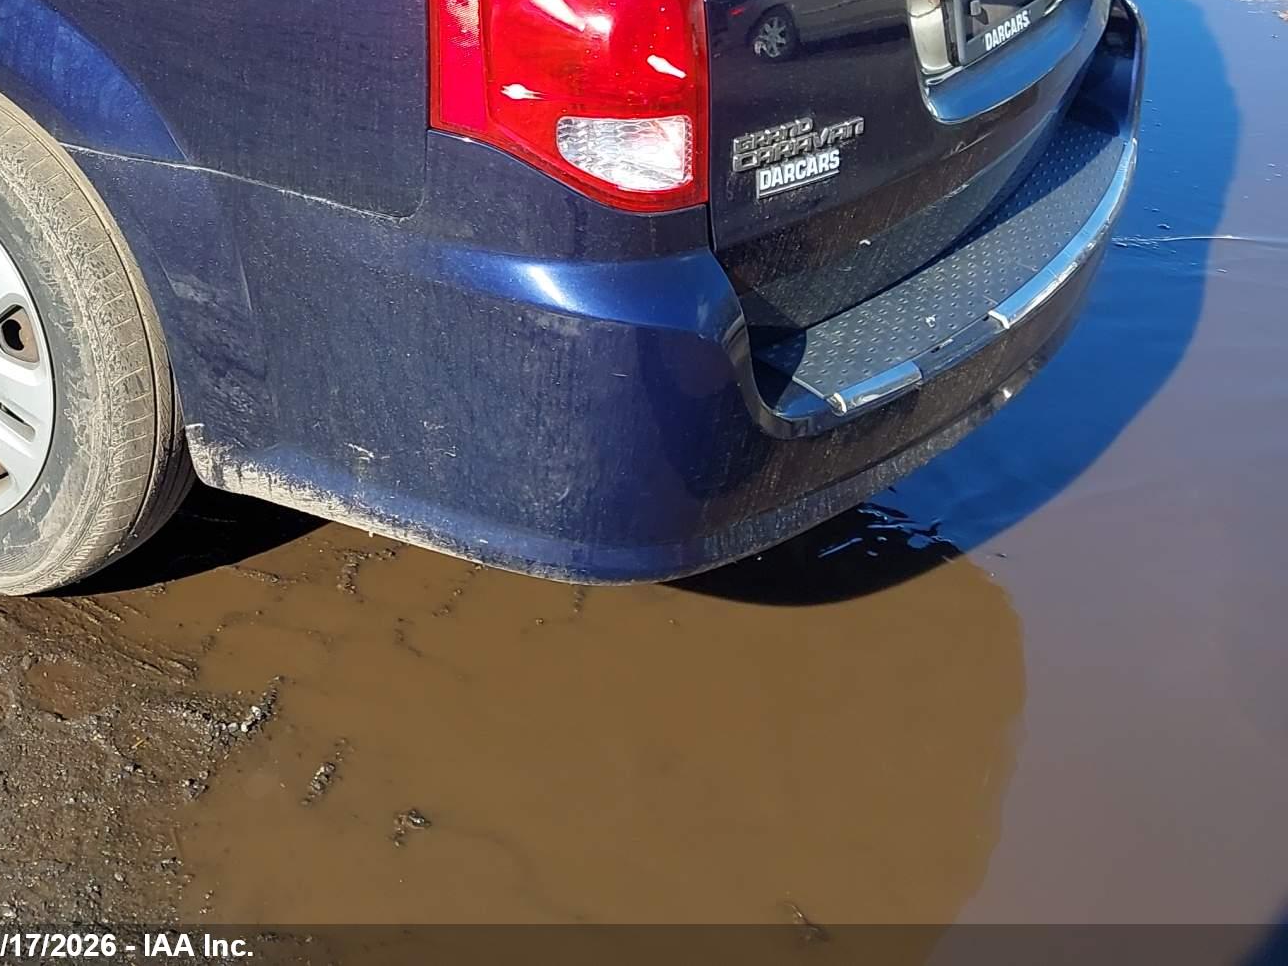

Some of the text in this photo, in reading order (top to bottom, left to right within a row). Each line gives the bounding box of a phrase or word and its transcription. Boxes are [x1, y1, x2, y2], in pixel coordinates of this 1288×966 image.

[984, 10, 1031, 51] DARCARS
[732, 117, 865, 172] CARAVAN
[733, 117, 813, 154] GRAND
[759, 148, 841, 190] DARCARS
